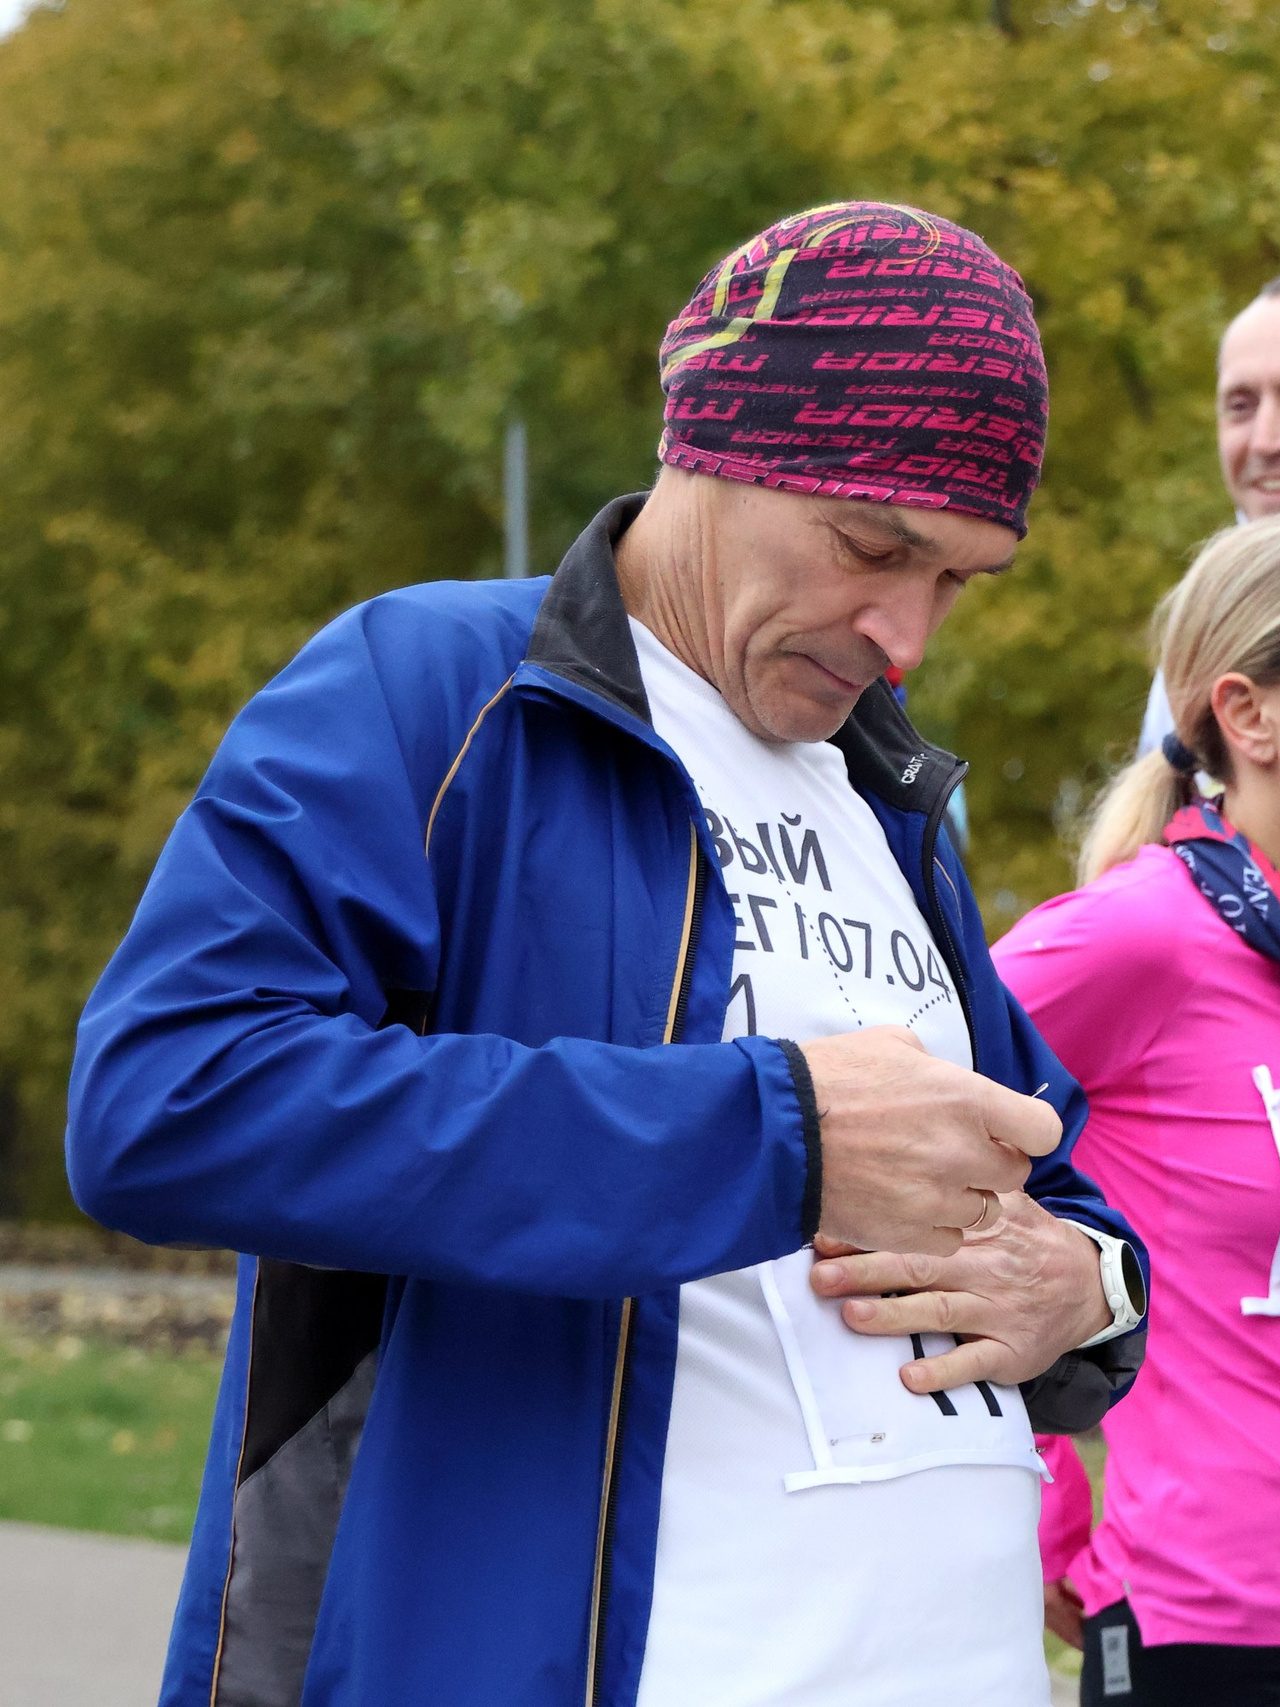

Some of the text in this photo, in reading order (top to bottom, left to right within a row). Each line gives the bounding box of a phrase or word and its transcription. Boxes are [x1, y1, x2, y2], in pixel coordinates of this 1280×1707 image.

[826, 258, 1002, 290] ERIDA
[845, 384, 981, 400] MERIDA
[793, 402, 1021, 443] ERIDA
[730, 430, 899, 450] MERIDA
